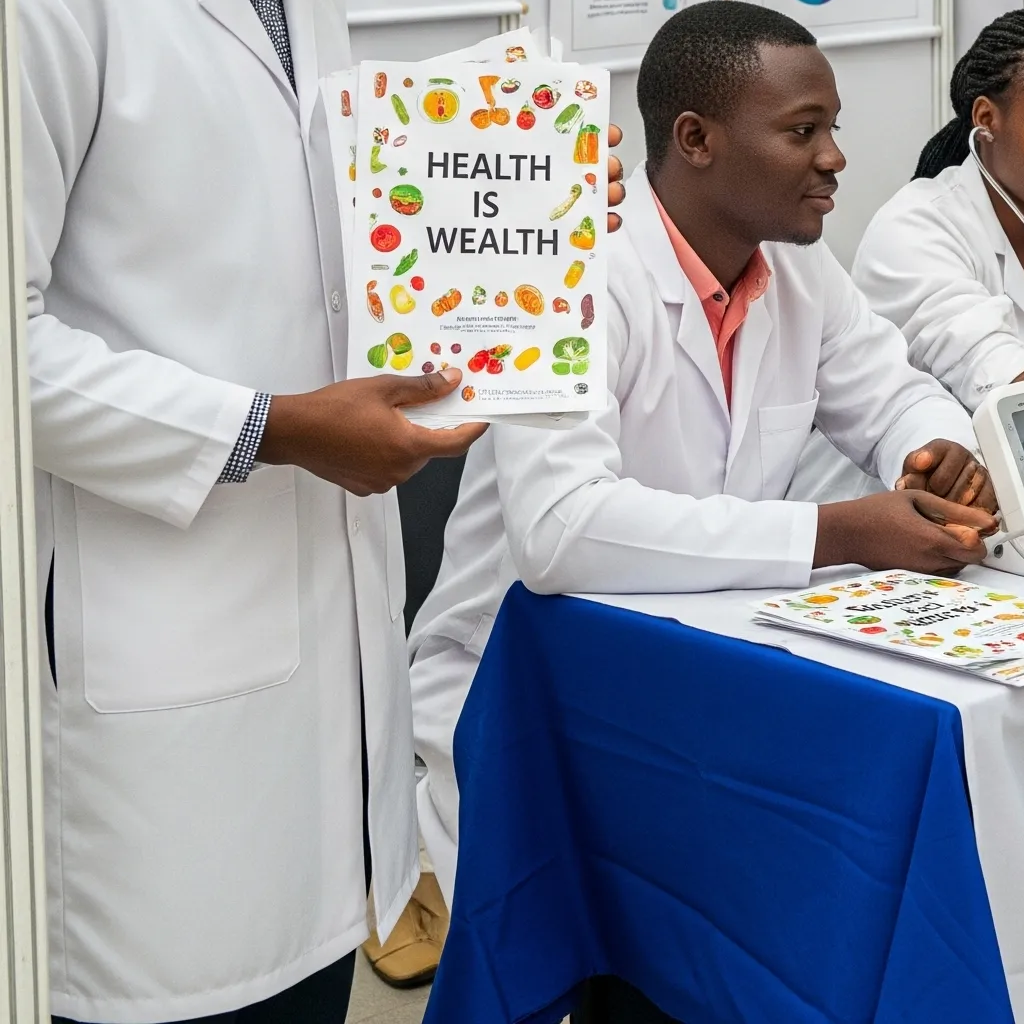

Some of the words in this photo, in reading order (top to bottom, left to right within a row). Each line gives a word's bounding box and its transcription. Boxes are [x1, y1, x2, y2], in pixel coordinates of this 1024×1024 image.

[427, 151, 551, 182] HEALTH
[473, 190, 499, 219] IS
[426, 226, 559, 256] WEALTH
